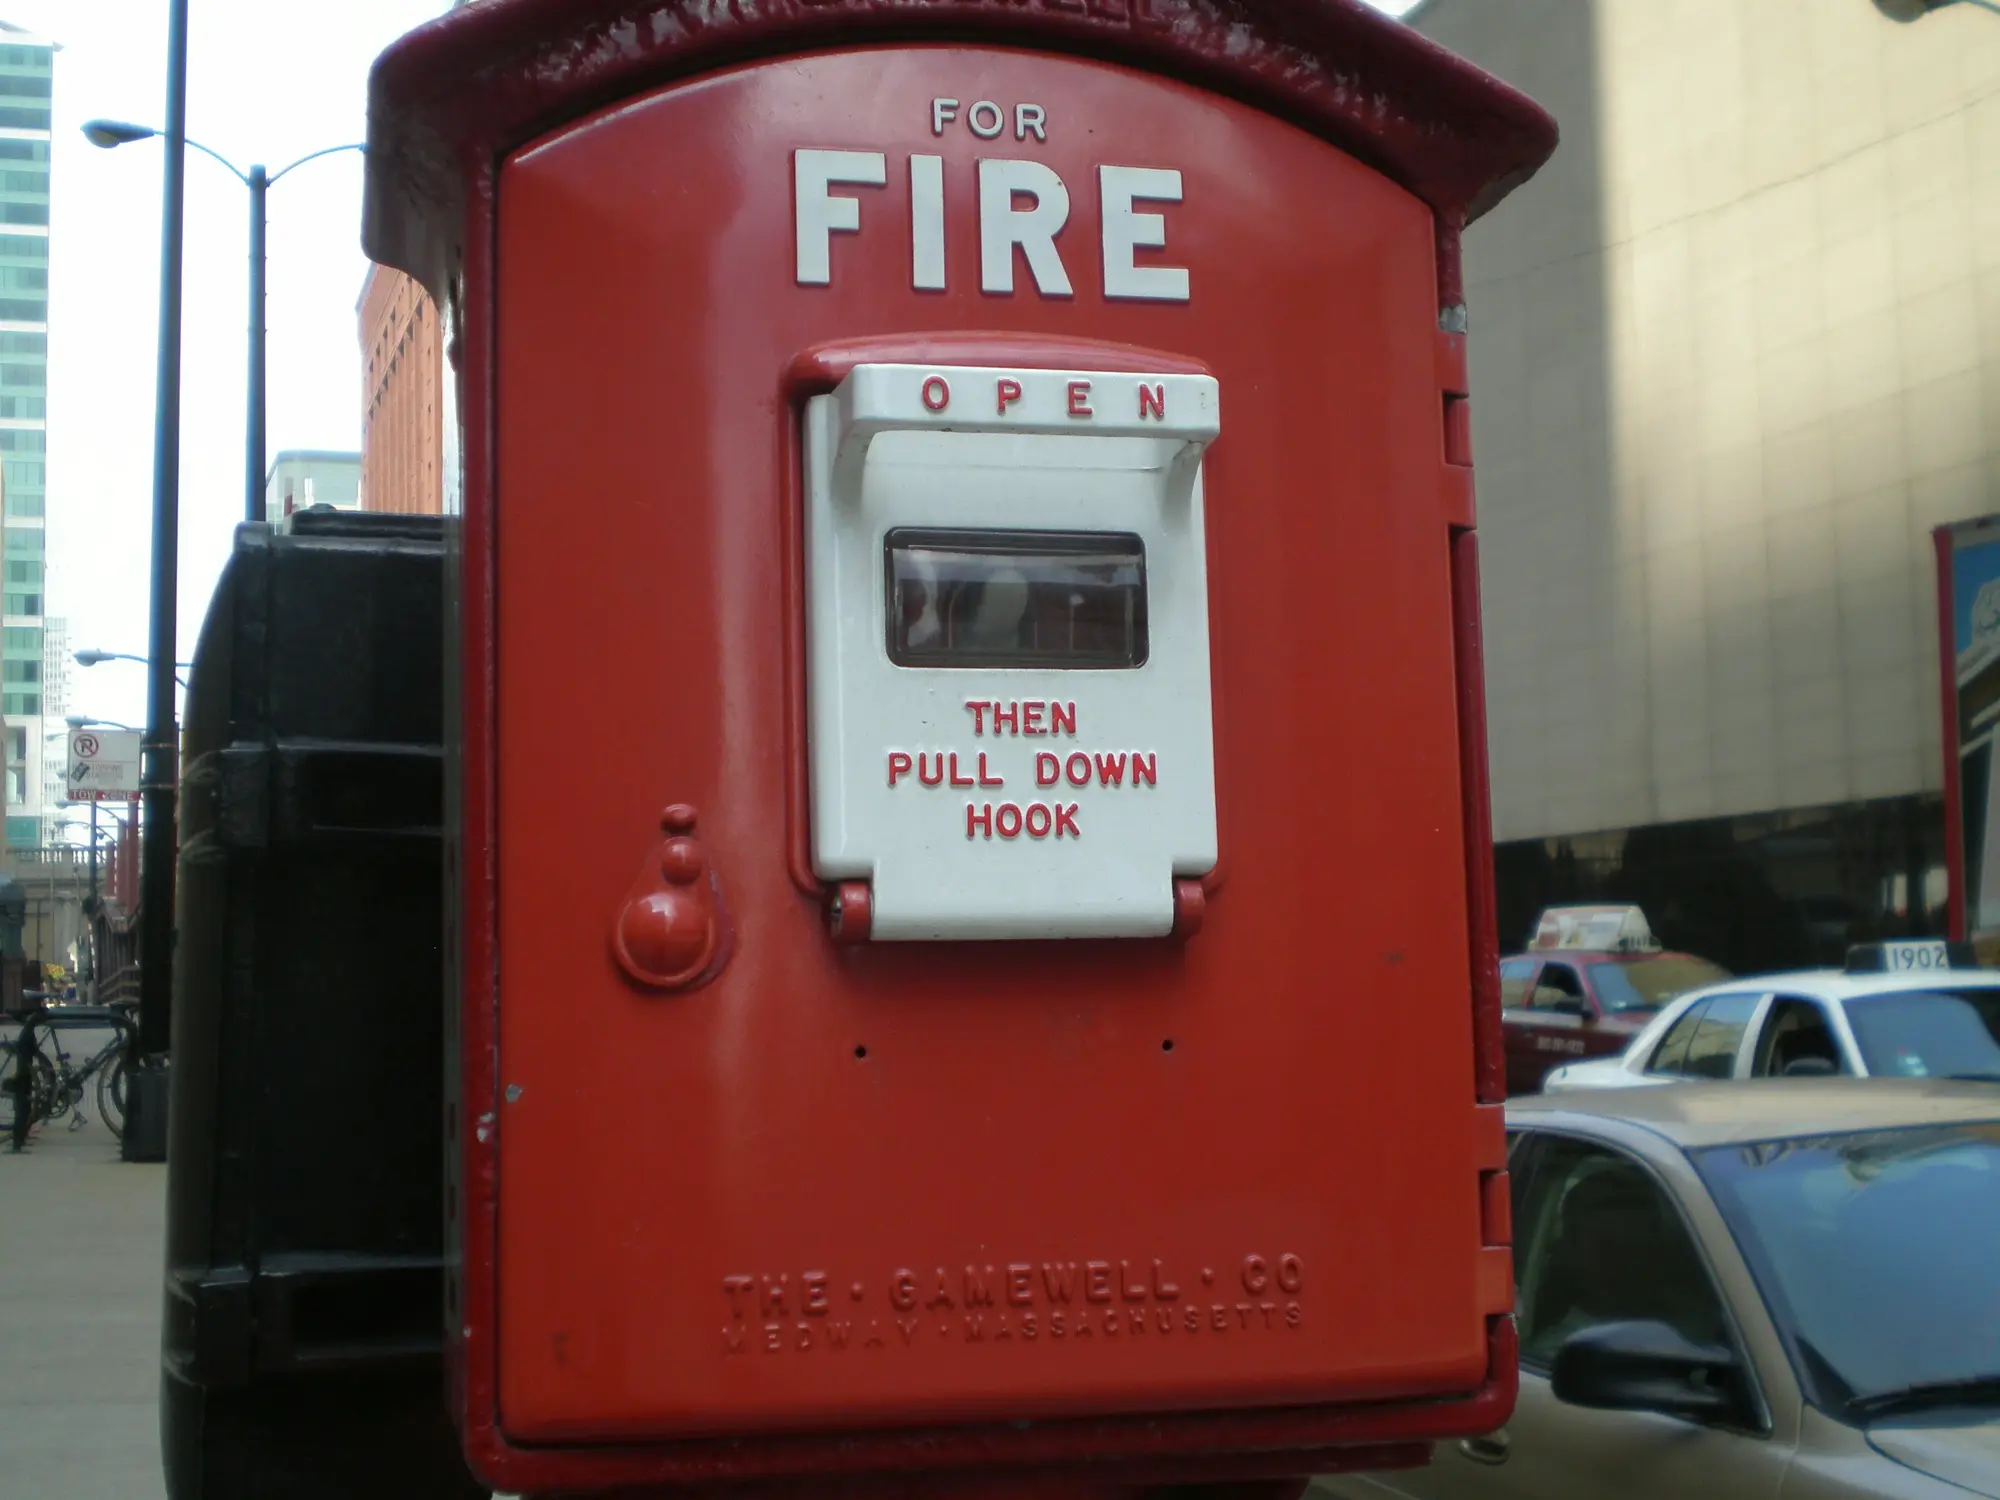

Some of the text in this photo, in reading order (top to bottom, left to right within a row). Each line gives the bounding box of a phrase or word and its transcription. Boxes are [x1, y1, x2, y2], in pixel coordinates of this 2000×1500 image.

[931, 98, 1047, 140] FOR
[794, 149, 1191, 301] FIRE
[922, 376, 1166, 419] OPEN
[965, 701, 1077, 735] THEN
[887, 751, 1157, 786] PULL DOWN
[965, 803, 1081, 838] HOOK
[1893, 945, 1946, 970] 1902
[723, 1251, 1303, 1319] THE GAMEWELL CO
